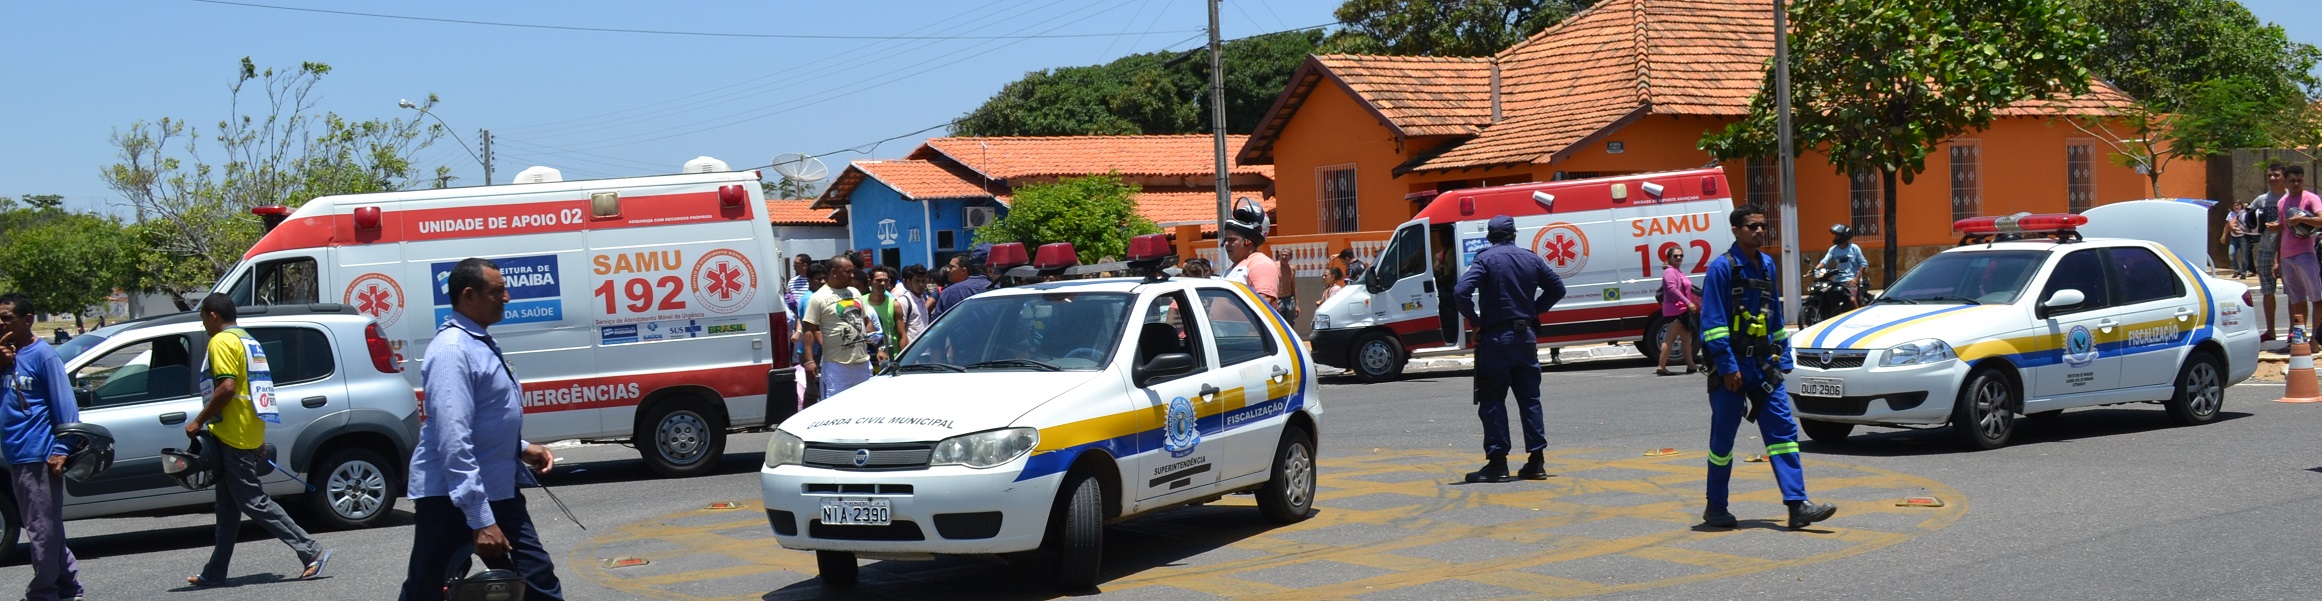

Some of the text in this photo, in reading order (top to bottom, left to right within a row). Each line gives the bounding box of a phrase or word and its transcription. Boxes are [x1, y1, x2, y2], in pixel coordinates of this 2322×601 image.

[419, 208, 583, 234] UNIDADE DE APOIO 02
[1632, 213, 1710, 238] SAMU
[500, 264, 550, 274] EITURA DE
[593, 250, 682, 276] SAMU
[503, 272, 555, 288] NAÍBA
[594, 276, 686, 314] 192
[504, 306, 554, 319] DA SAÚDE
[670, 326, 684, 334] SUS
[708, 322, 746, 334] BRASIL
[2128, 322, 2178, 346] FISCALIZAÇÃO
[522, 382, 640, 408] MERGÊNCIAS
[806, 418, 852, 430] GUARDA
[888, 416, 954, 430] MUNICIPAL
[1226, 402, 1284, 426] FISCALIZAÇÃO
[1154, 456, 1206, 476] SUPERINTENDÊNCIA
